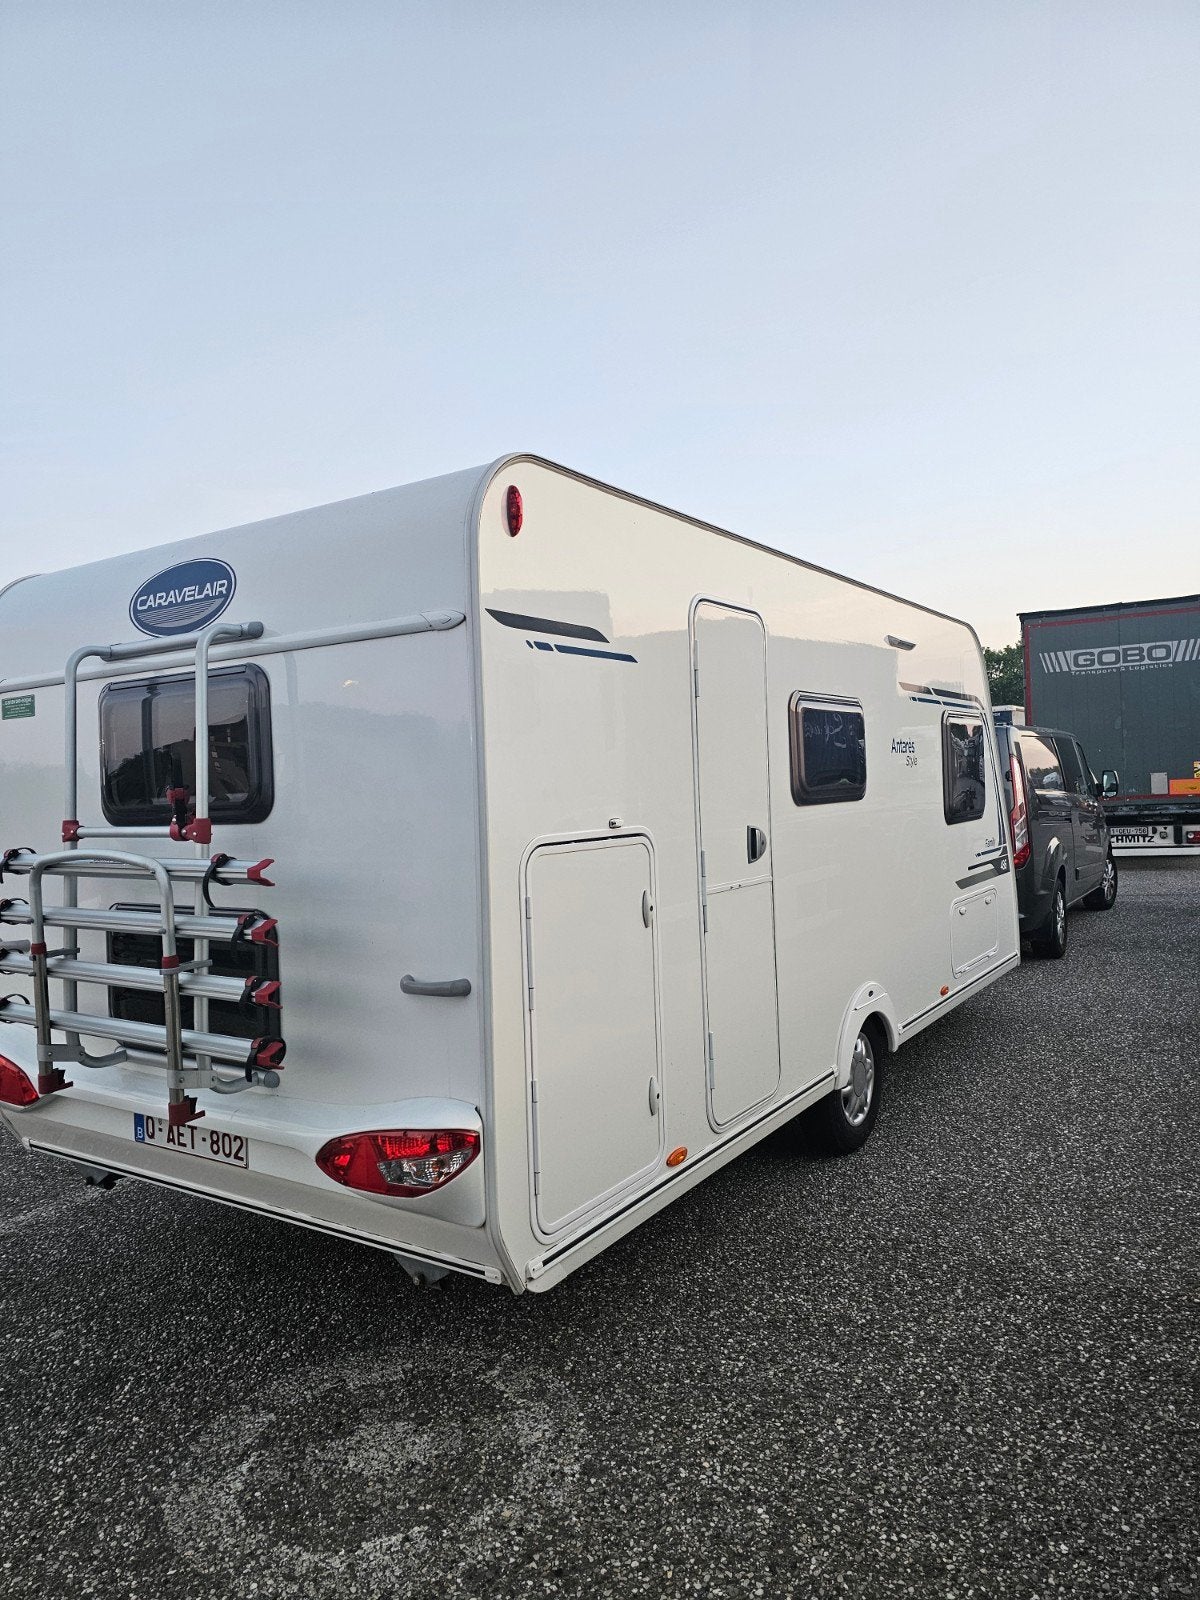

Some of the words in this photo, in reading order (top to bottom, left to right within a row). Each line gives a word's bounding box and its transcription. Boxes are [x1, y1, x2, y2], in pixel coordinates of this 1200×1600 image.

[137, 580, 228, 610] CARAVELAIR
[1071, 667, 1117, 676] Transport
[1129, 662, 1173, 671] Logistics
[1072, 644, 1172, 669] GOBO
[137, 1127, 143, 1139] B
[145, 1115, 245, 1161] Q-AET-802
